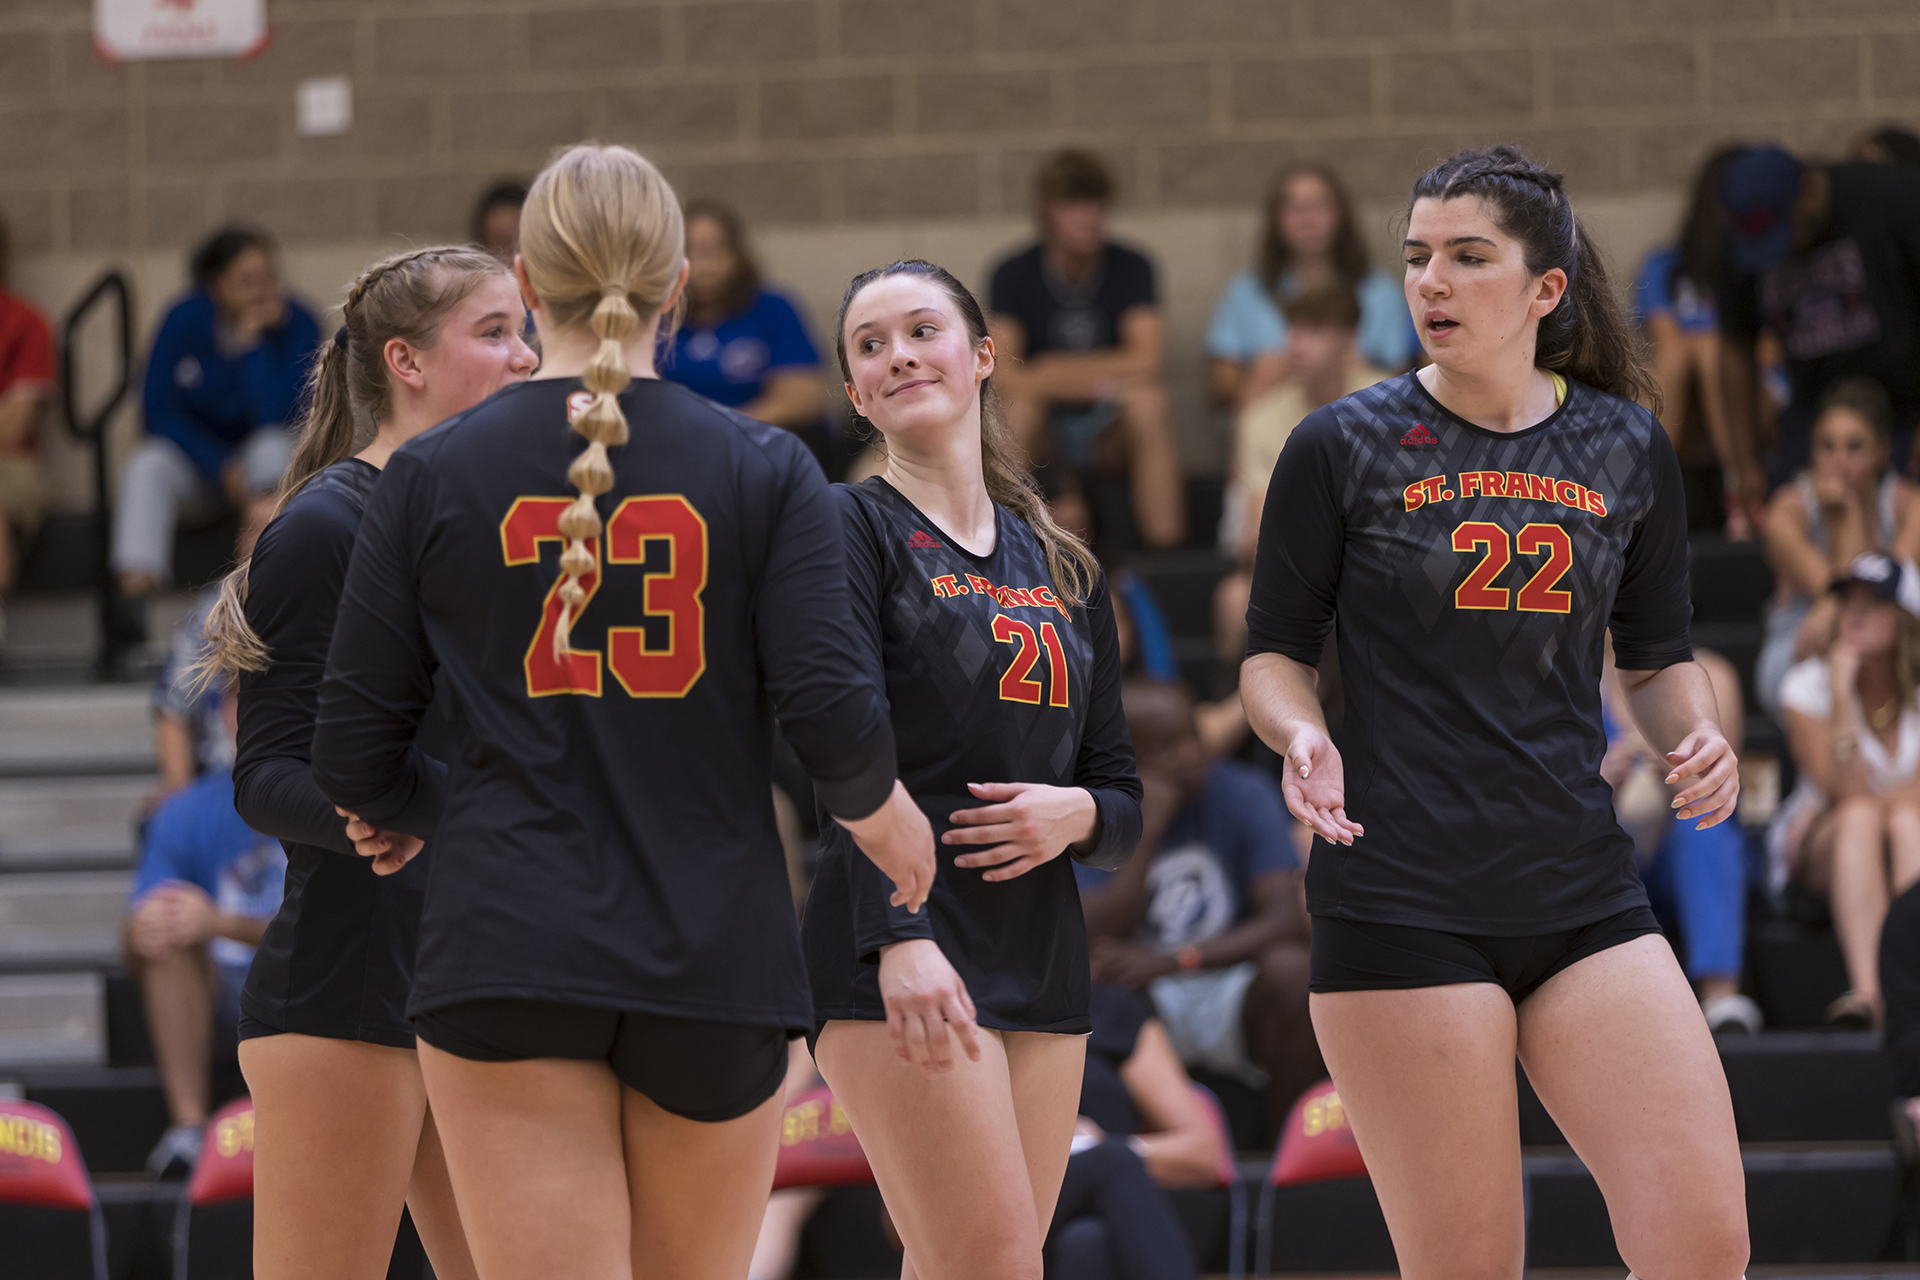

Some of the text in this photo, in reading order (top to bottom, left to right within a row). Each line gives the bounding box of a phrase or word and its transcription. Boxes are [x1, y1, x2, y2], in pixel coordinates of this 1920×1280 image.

[1399, 435, 1439, 446] adidas
[1403, 471, 1608, 517] ST. FRANCIS
[500, 494, 709, 698] 23
[964, 573, 1072, 623] FRANC
[1451, 521, 1573, 613] 22
[990, 613, 1069, 708] 21
